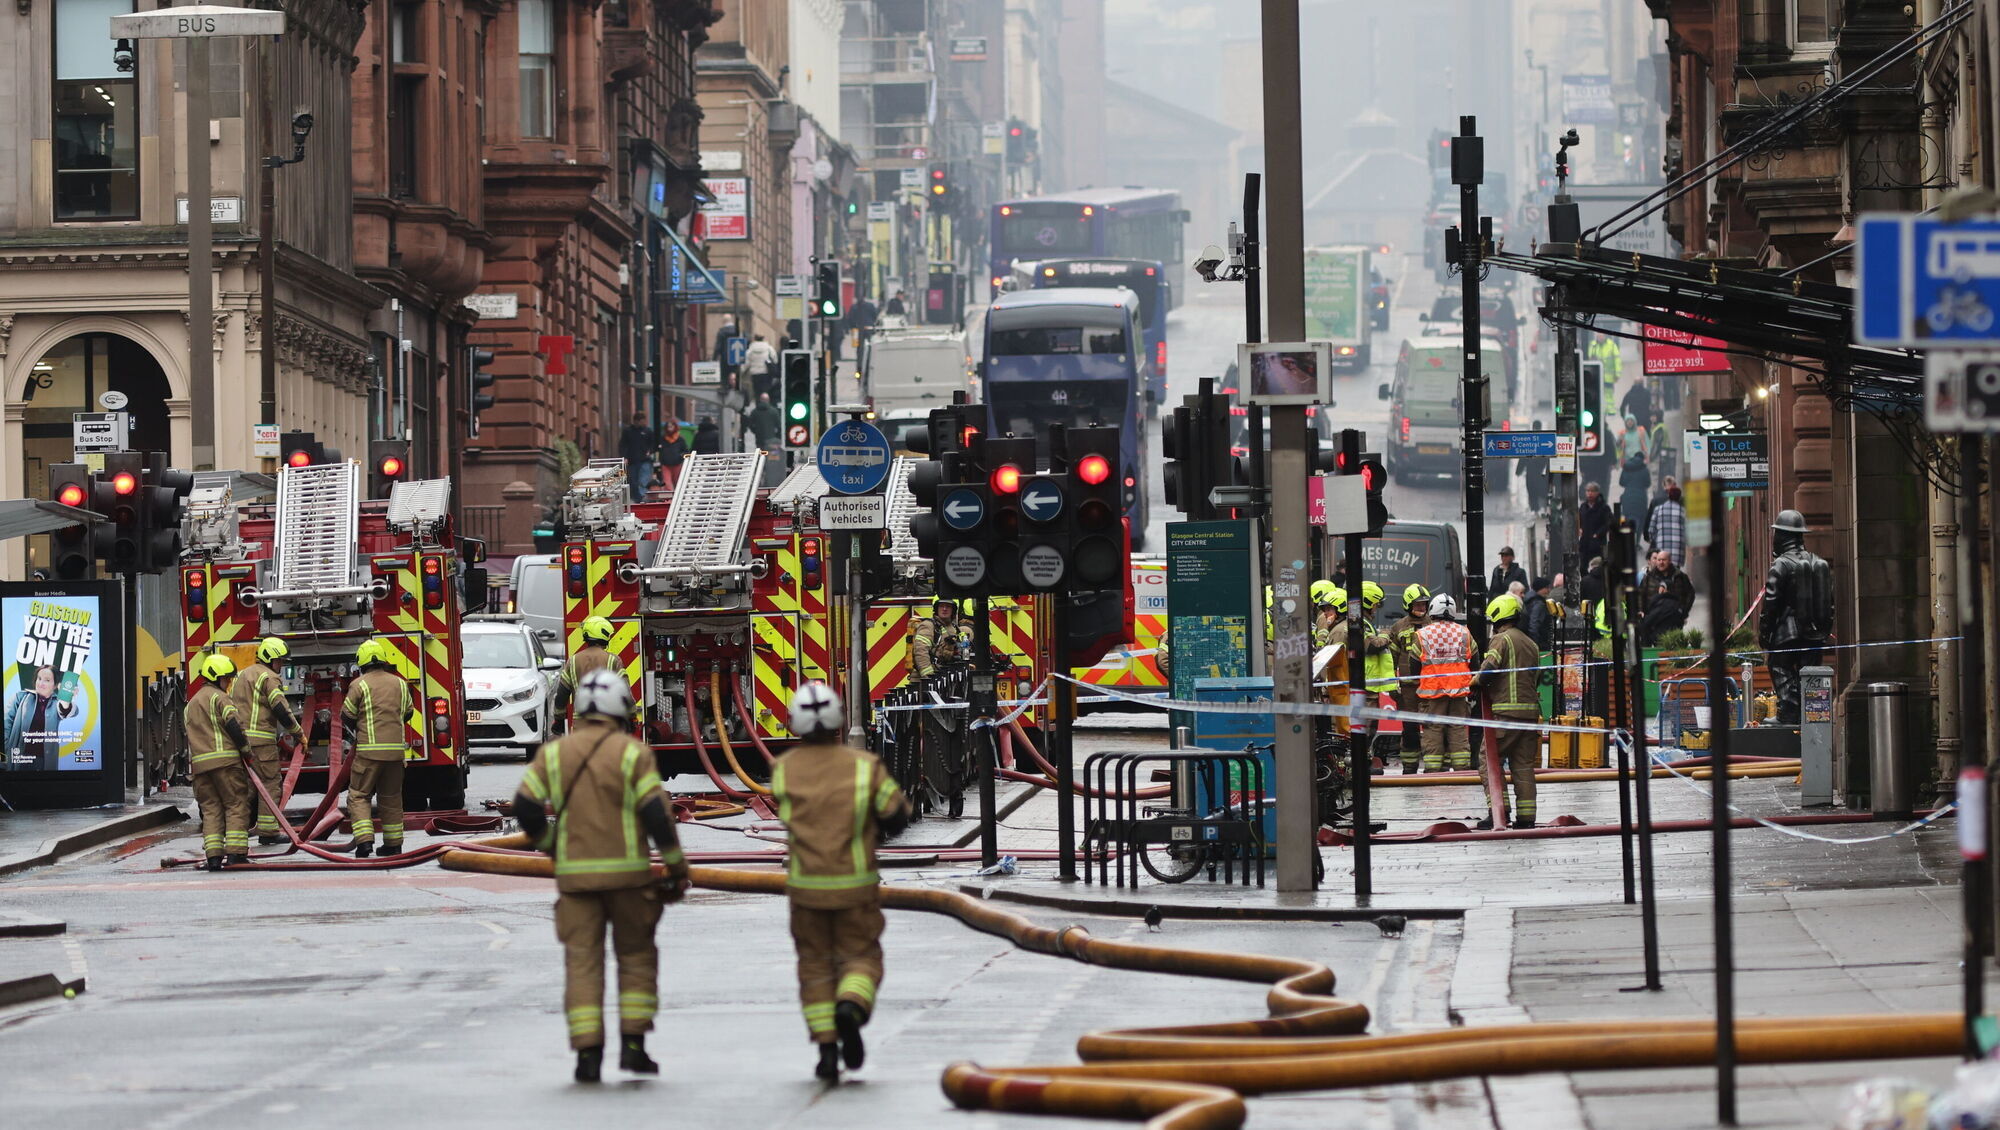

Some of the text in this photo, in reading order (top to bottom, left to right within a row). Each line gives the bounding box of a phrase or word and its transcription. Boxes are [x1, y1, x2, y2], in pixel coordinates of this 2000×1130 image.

[178, 17, 216, 33] BUS
[724, 182, 745, 194] SELL
[1647, 358, 1705, 369] 0141 221 9191
[79, 435, 113, 444] Bus Stop
[1711, 439, 1752, 451] To Let
[1557, 442, 1573, 450] CCTV
[1713, 465, 1736, 473] Ryden
[841, 474, 864, 485] taxi
[824, 501, 880, 512] Authorised
[831, 513, 873, 524] vehicles
[1387, 547, 1420, 567] CLAY
[1147, 597, 1165, 607] 101
[31, 600, 91, 627] GLASGOW
[23, 614, 94, 649] YOU'RE
[16, 636, 90, 675] ON IT
[1206, 827, 1216, 839] P
